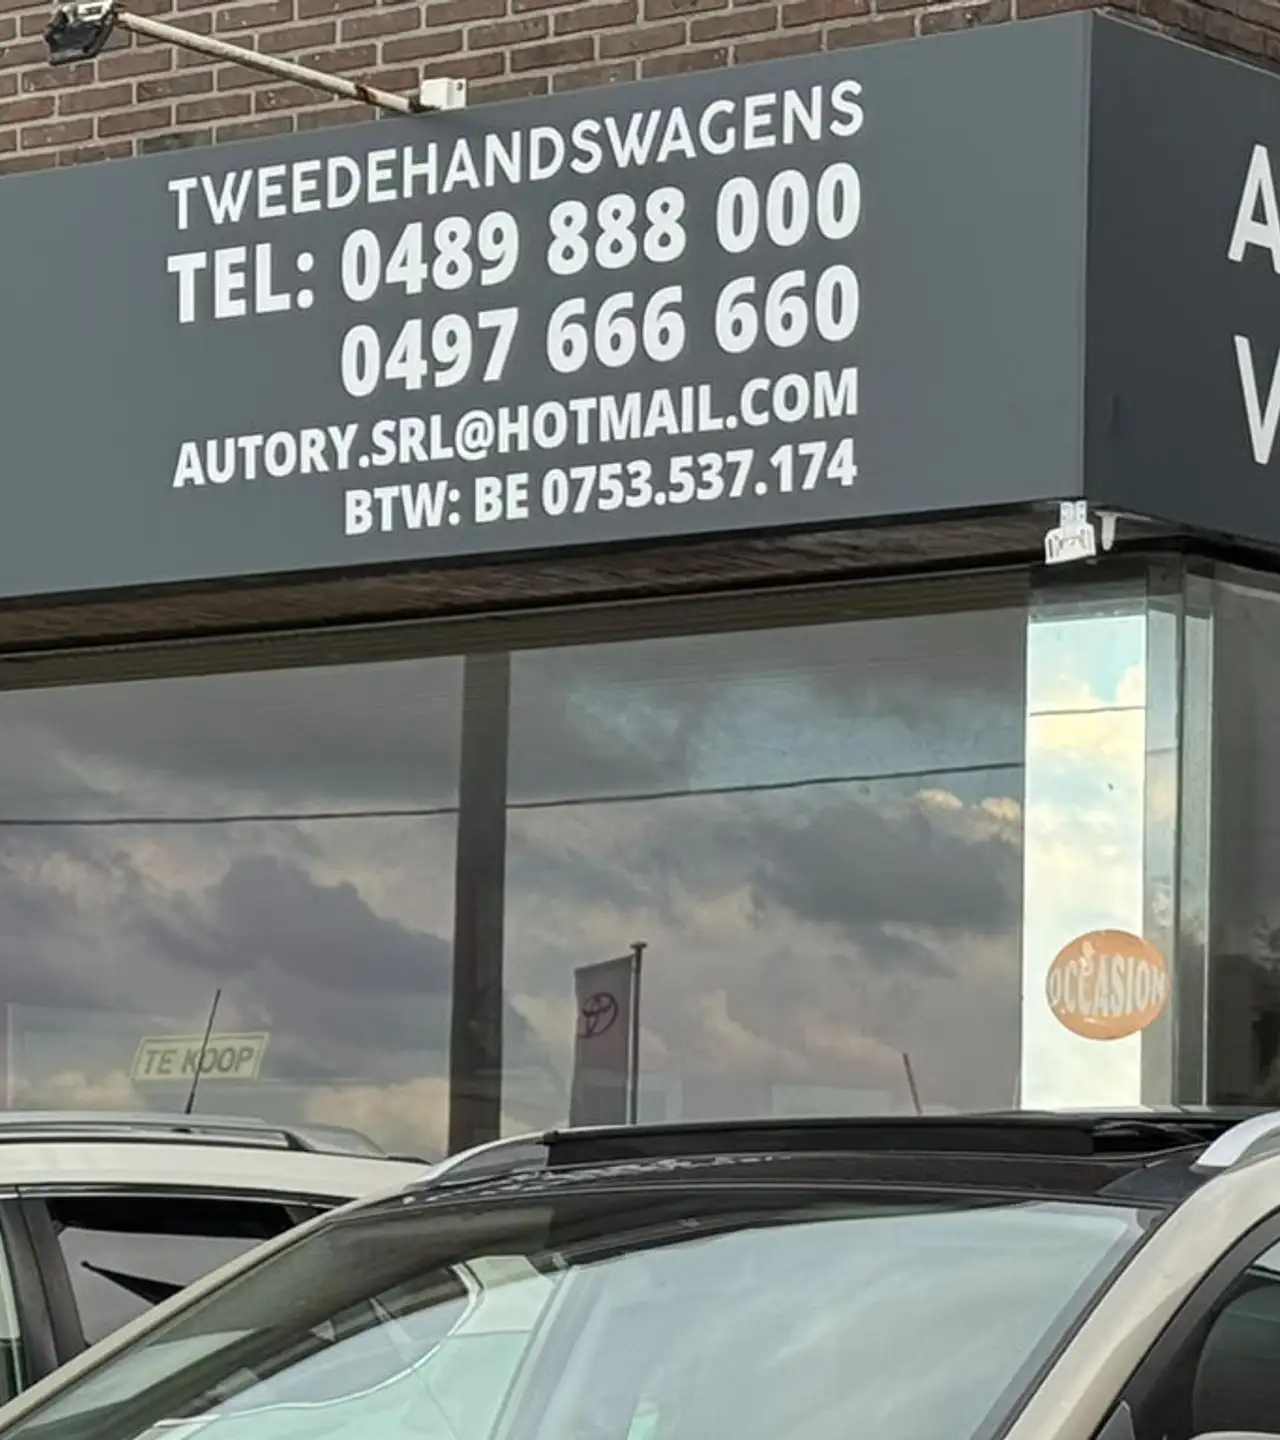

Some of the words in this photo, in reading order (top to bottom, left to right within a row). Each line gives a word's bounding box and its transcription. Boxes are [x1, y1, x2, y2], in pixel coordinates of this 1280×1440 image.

[168, 79, 864, 230] TWEEDEHANDSWAGENS
[167, 242, 314, 324] TEL:
[341, 210, 519, 302] 0489
[547, 186, 687, 275] 888
[716, 162, 861, 253] 000
[341, 307, 519, 397] 0497
[546, 285, 686, 373] 666
[715, 264, 860, 353] 660
[172, 367, 858, 488] AUTORY.SRL@HOTMAIL.COM
[345, 480, 461, 535] BTW:
[475, 472, 529, 523] BE
[542, 438, 858, 516] 0753.537.174
[1049, 953, 1167, 1018] OCCASION
[143, 1049, 177, 1075] TE
[181, 1045, 255, 1074] KOOP
